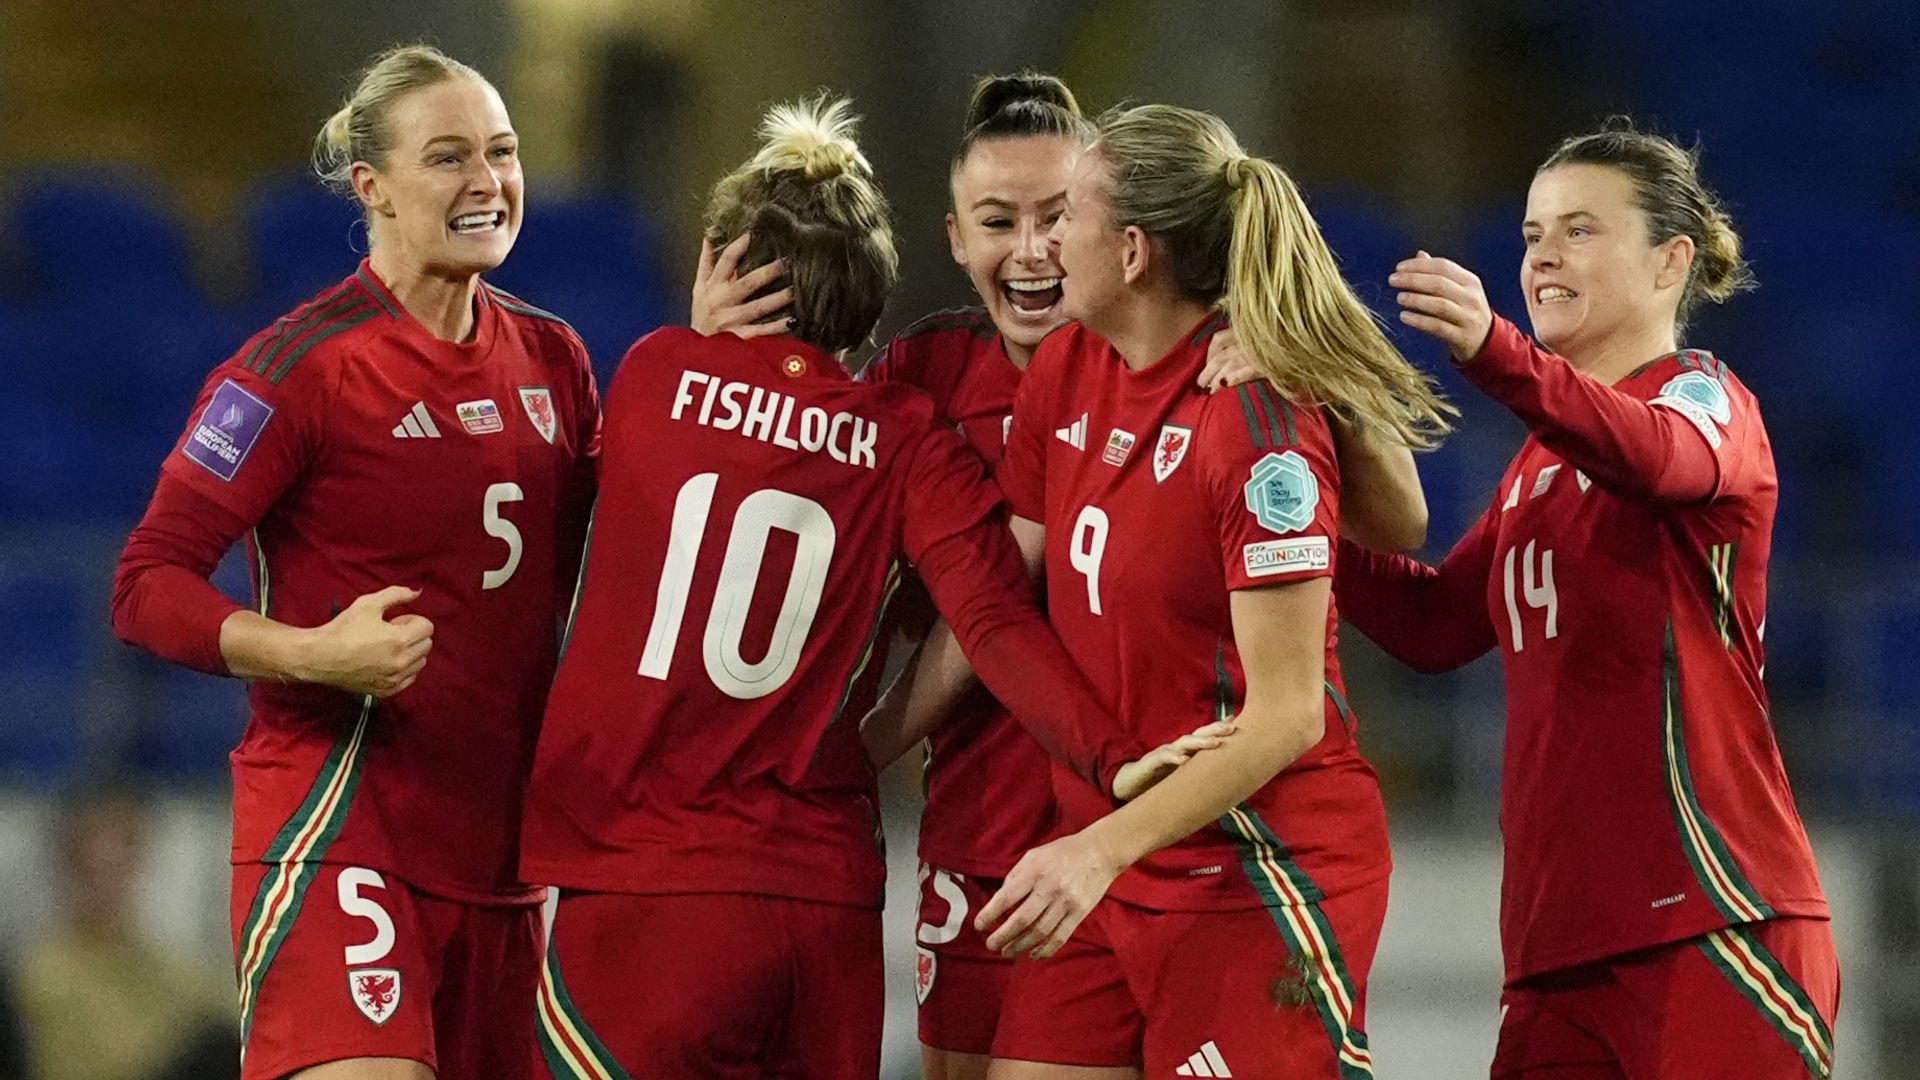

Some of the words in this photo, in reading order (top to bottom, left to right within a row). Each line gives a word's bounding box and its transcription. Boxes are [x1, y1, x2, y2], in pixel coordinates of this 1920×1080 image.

[194, 431, 237, 464] QUALIFIERS
[199, 425, 241, 456] EUROPEAN
[671, 369, 878, 469] FISHLOCK
[482, 482, 524, 590] 5
[1069, 504, 1110, 616] 9
[1247, 548, 1327, 566] FOUNDATION
[637, 472, 836, 700] 10
[1504, 538, 1558, 653] 14
[337, 866, 396, 965] 5
[918, 862, 969, 944] 5
